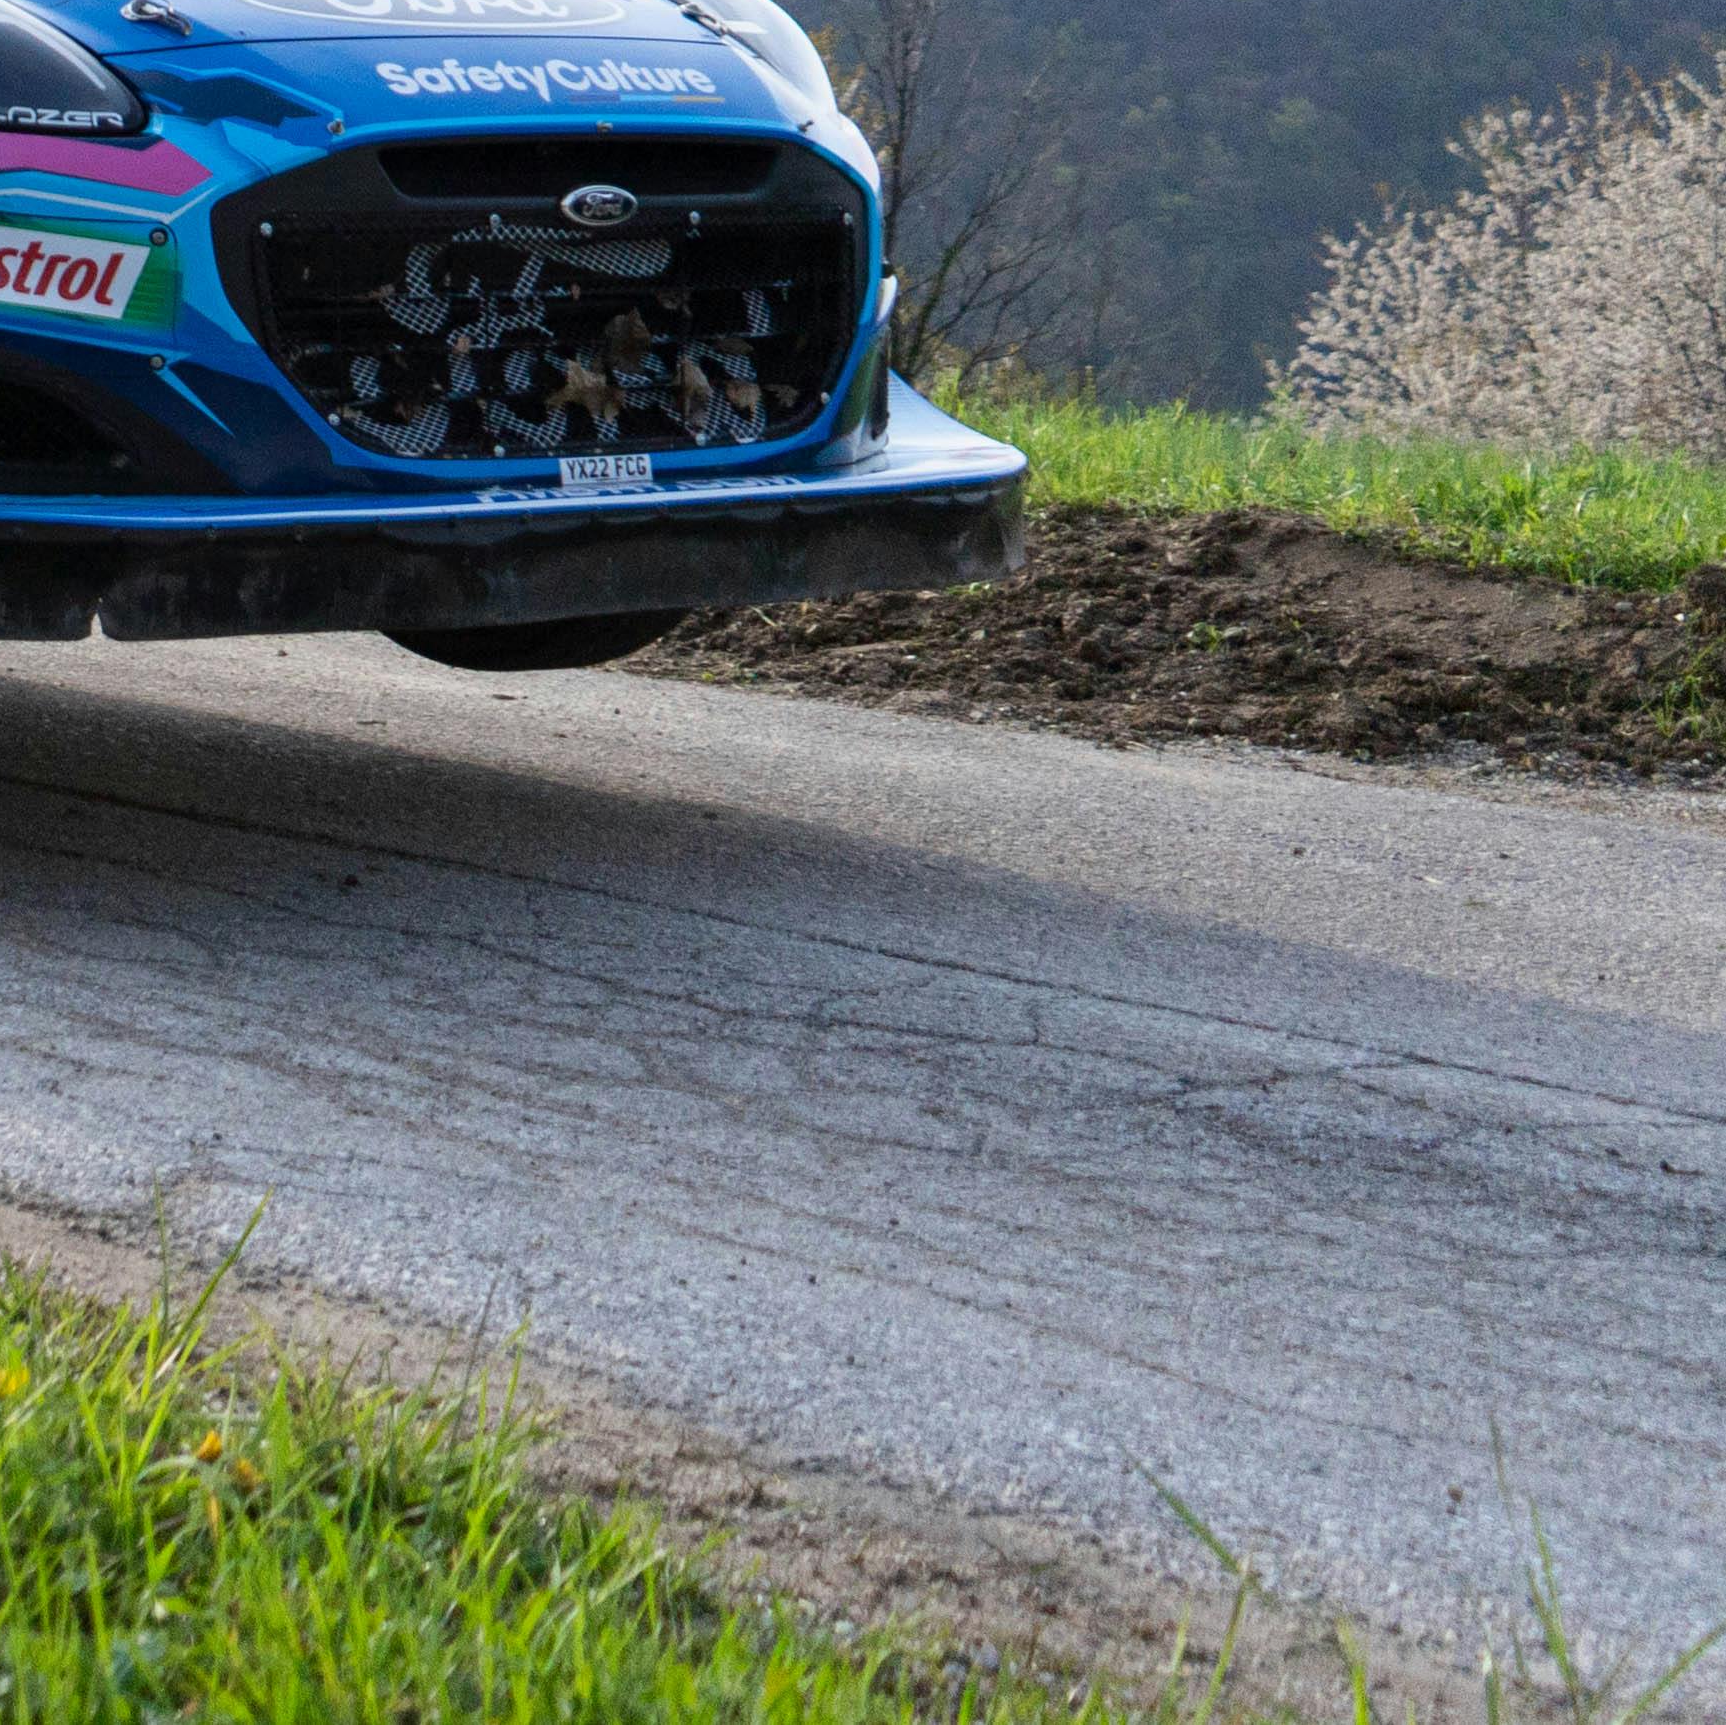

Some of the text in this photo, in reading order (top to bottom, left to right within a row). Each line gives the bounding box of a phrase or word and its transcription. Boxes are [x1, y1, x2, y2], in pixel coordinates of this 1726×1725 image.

[375, 58, 717, 102] SafetyCulture
[582, 192, 624, 218] Ford
[567, 455, 647, 480] YX22 FCG
